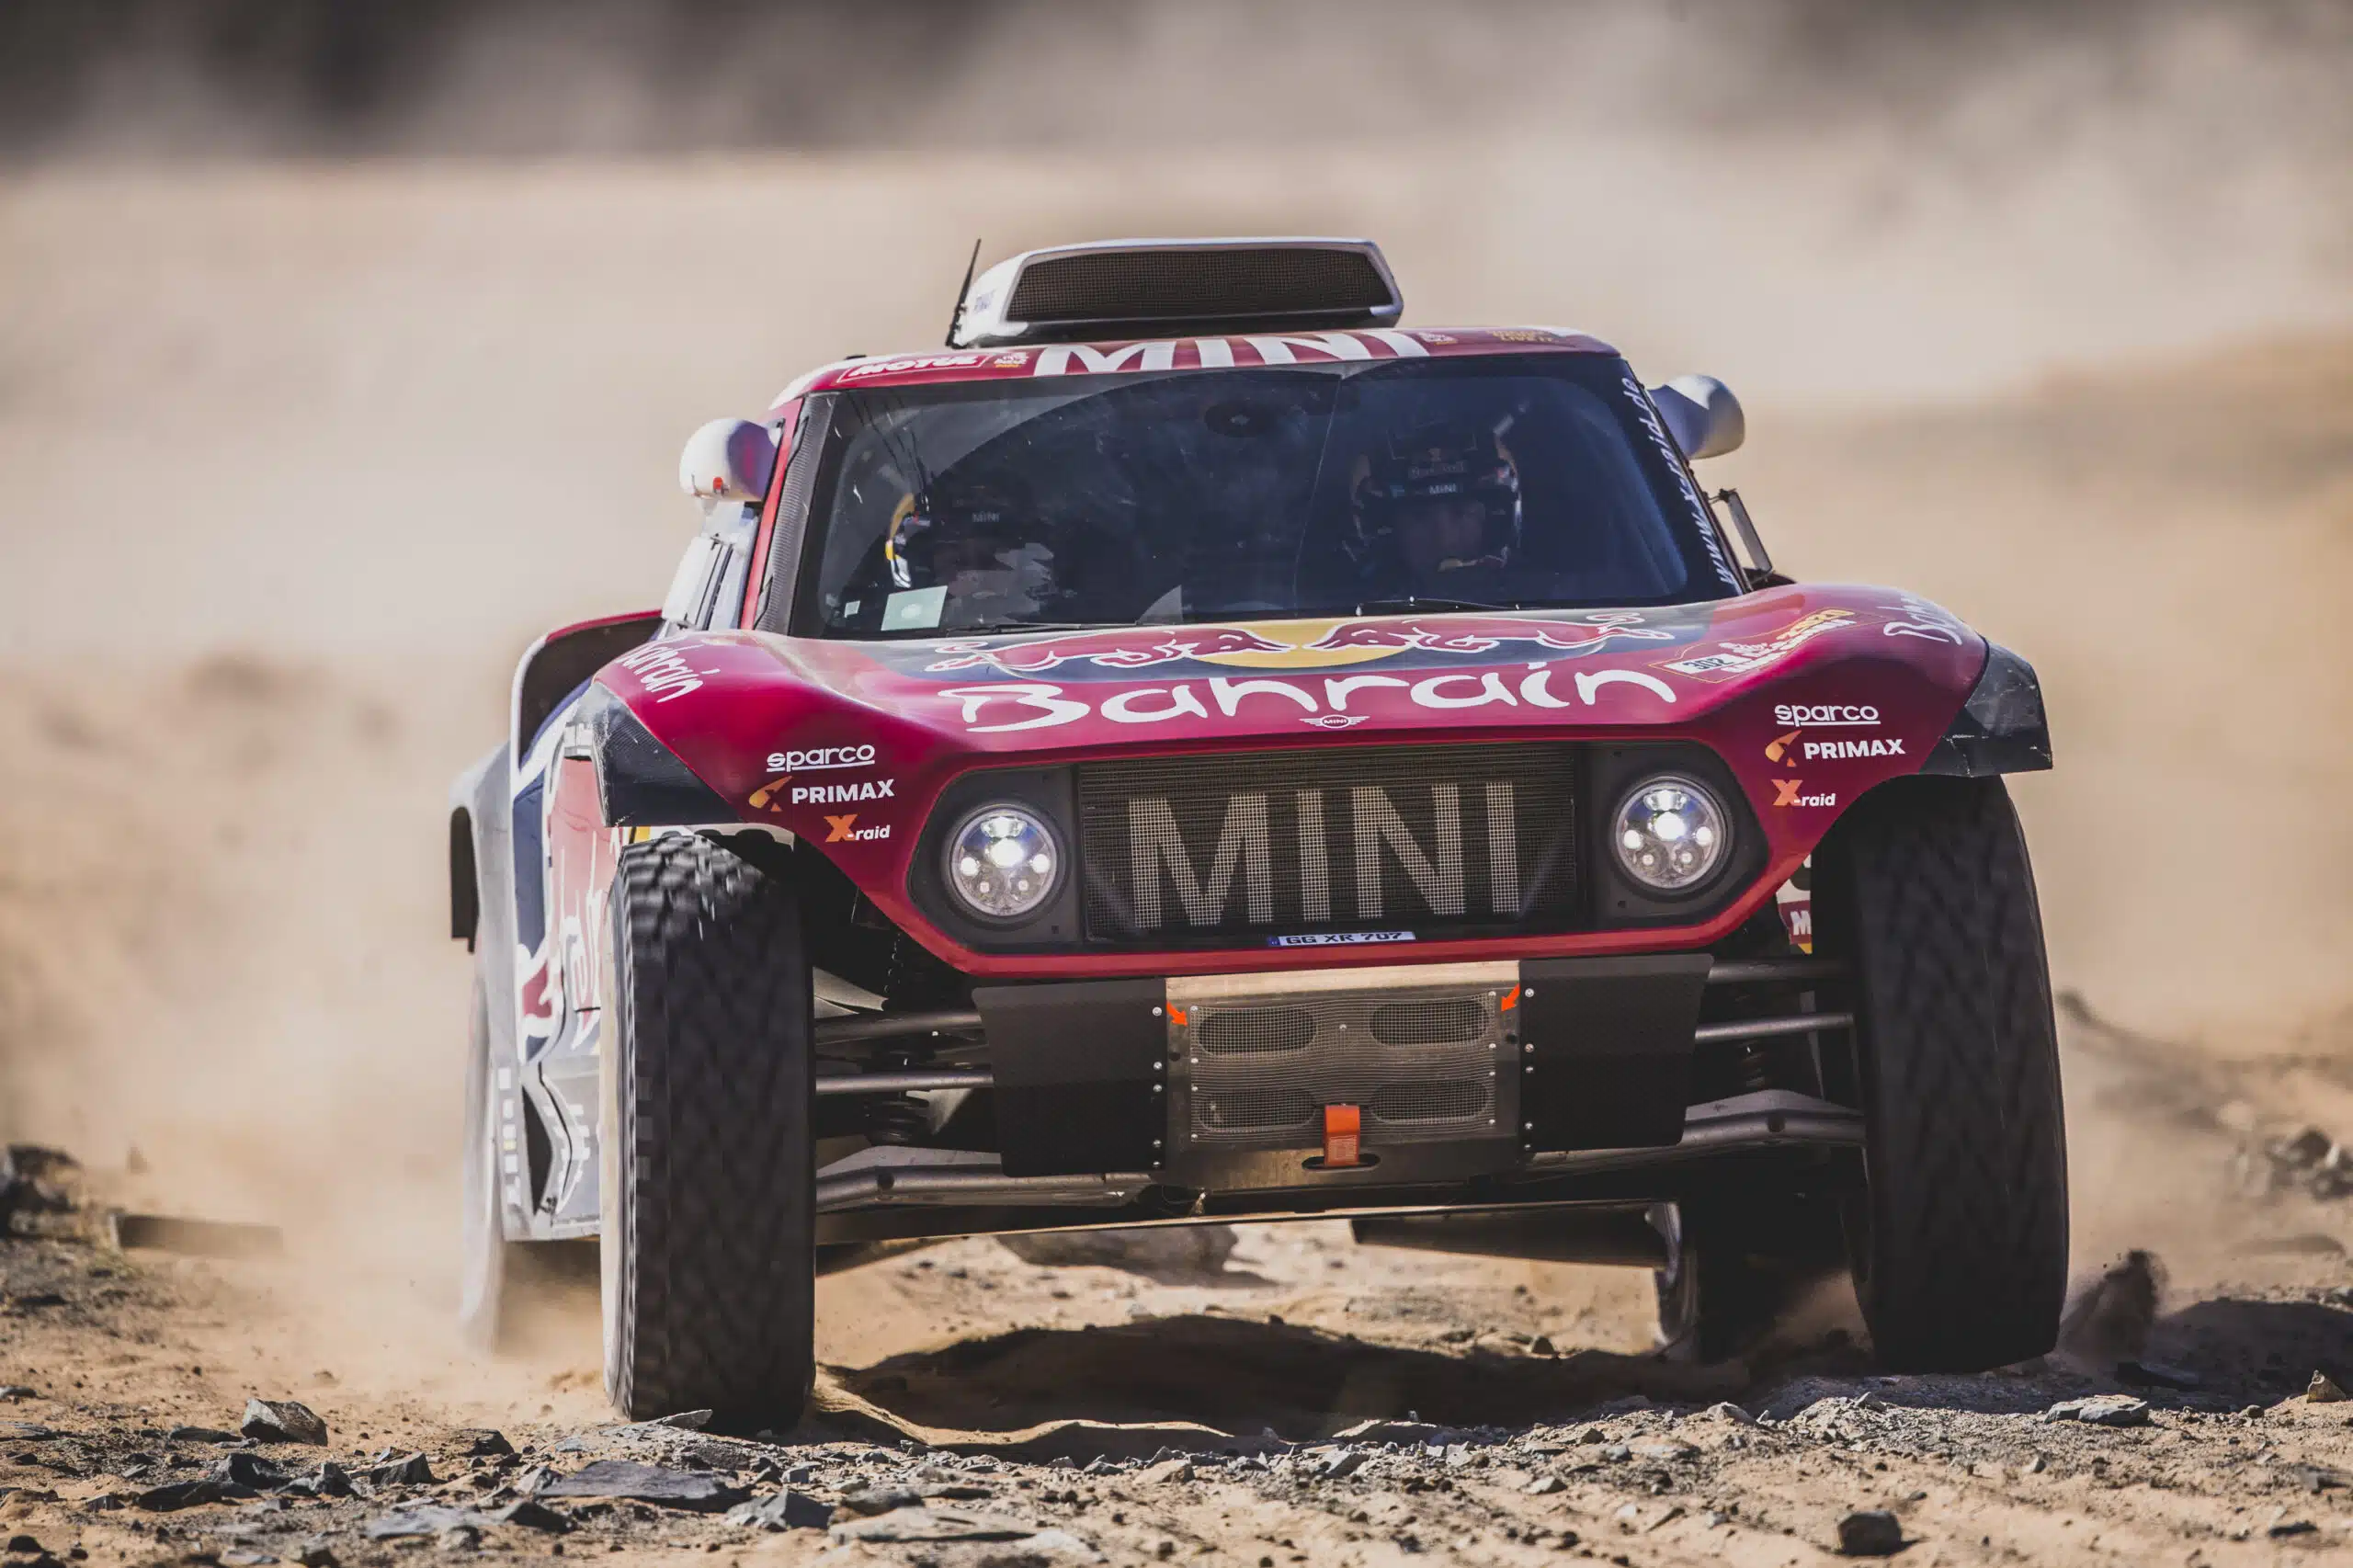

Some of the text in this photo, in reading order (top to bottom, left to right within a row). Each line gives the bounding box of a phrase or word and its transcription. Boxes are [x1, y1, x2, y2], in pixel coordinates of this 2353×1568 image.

[1034, 329, 1430, 378] MINI
[938, 662, 1677, 733] Bahrain
[1775, 704, 1881, 727] sparco
[767, 744, 876, 773] sparco
[1803, 738, 1906, 760] PRIMAX
[792, 778, 895, 804] PRIMAX
[1770, 778, 1836, 806] X-raid
[824, 812, 891, 843] X-raid
[1129, 781, 1521, 929] MINI
[1286, 932, 1403, 945] GG XR 707
